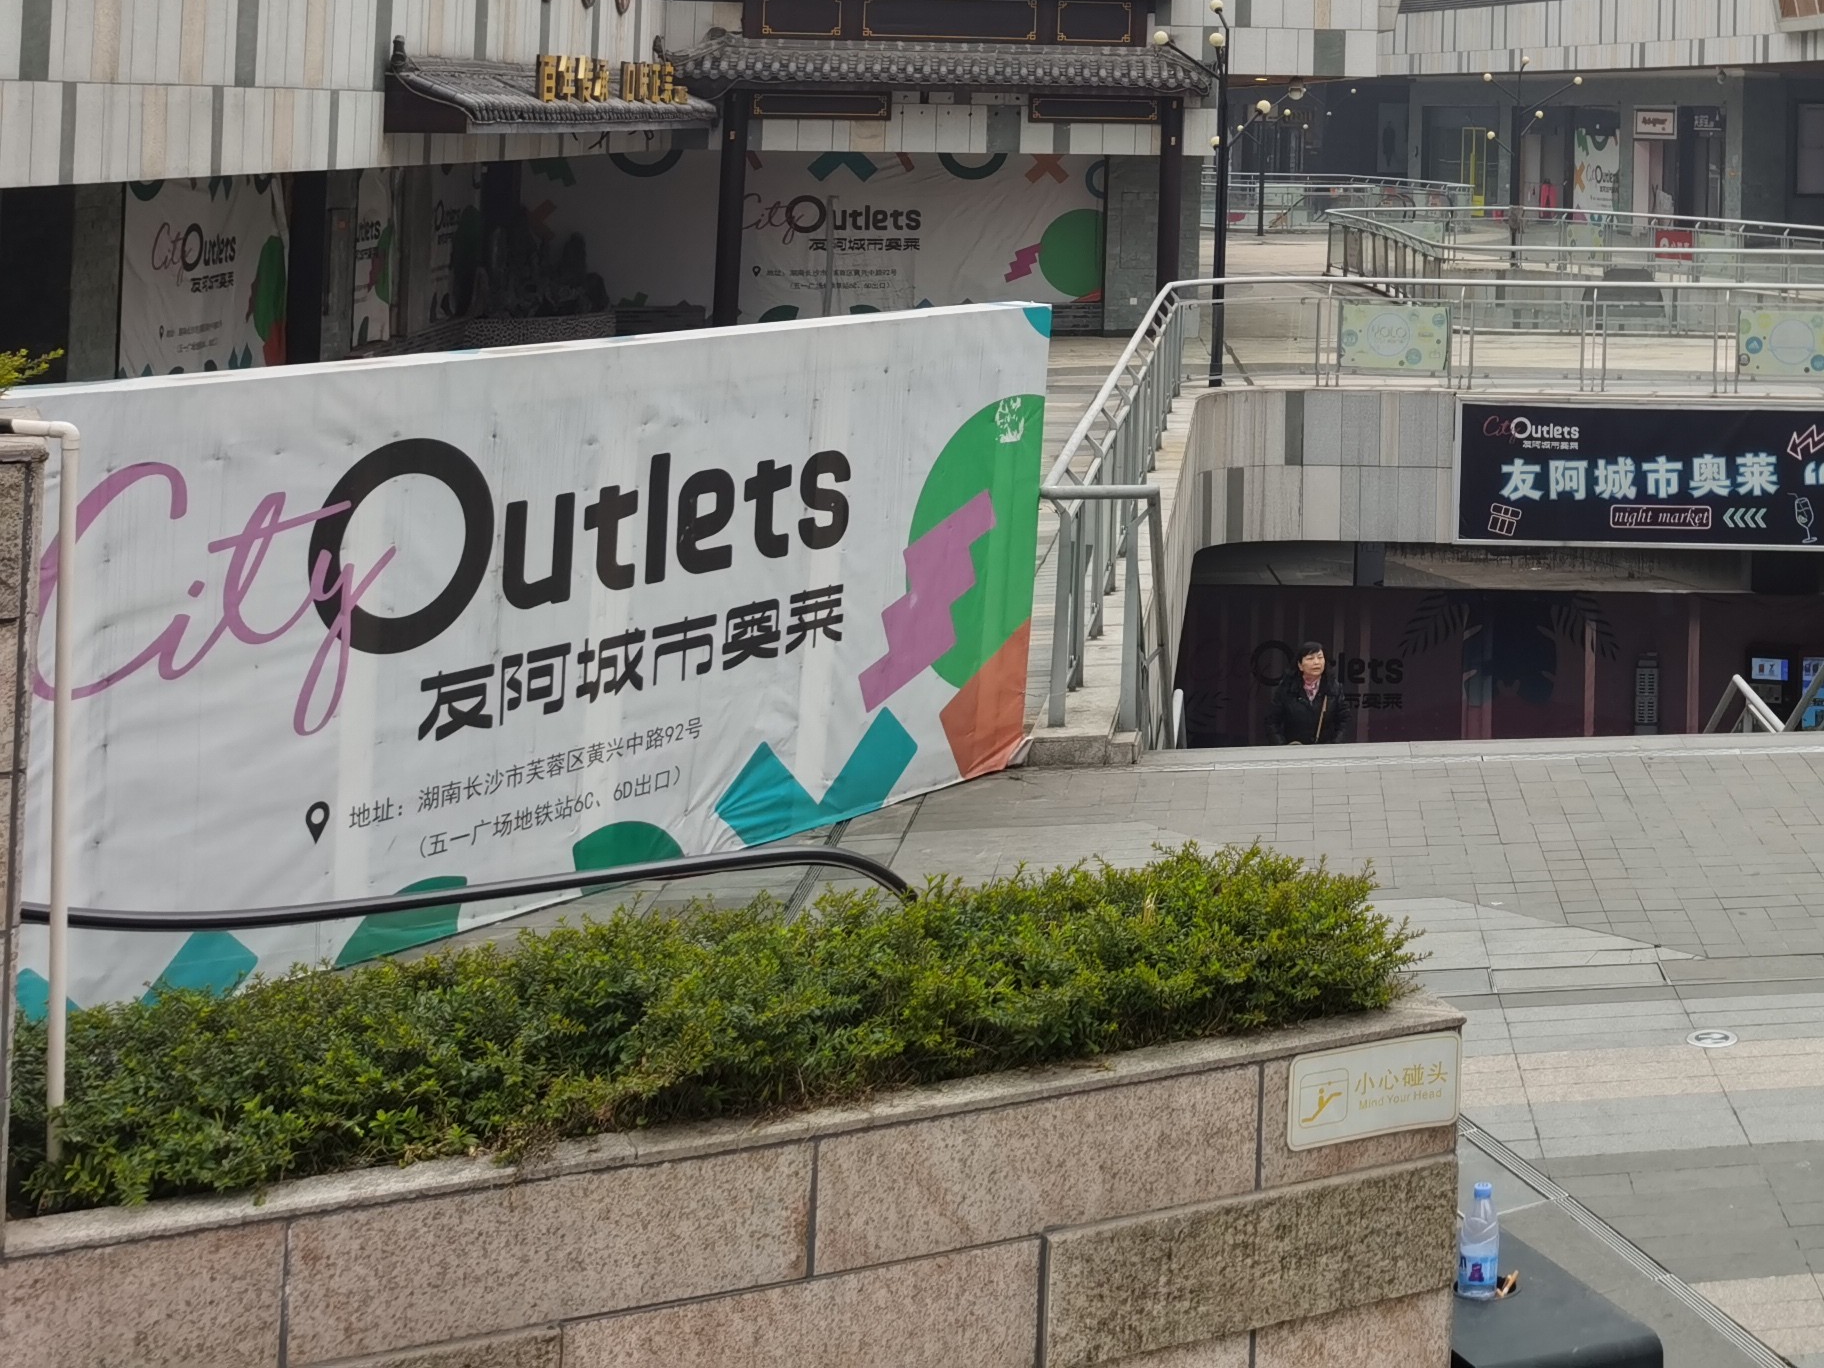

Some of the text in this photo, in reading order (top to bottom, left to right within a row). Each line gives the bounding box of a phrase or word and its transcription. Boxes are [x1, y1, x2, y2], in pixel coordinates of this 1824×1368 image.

[785, 195, 922, 233] Outlets
[1510, 416, 1580, 440] Outlets
[1499, 452, 1780, 501] 友阿城市奥莱
[1613, 506, 1710, 528] night market
[307, 438, 852, 655] Outlets
[417, 583, 845, 742] 友阿城市奥莱
[1250, 640, 1404, 686] Olets
[1354, 1060, 1449, 1096] 小心碰头
[1359, 1087, 1443, 1111] Mind Your Head
